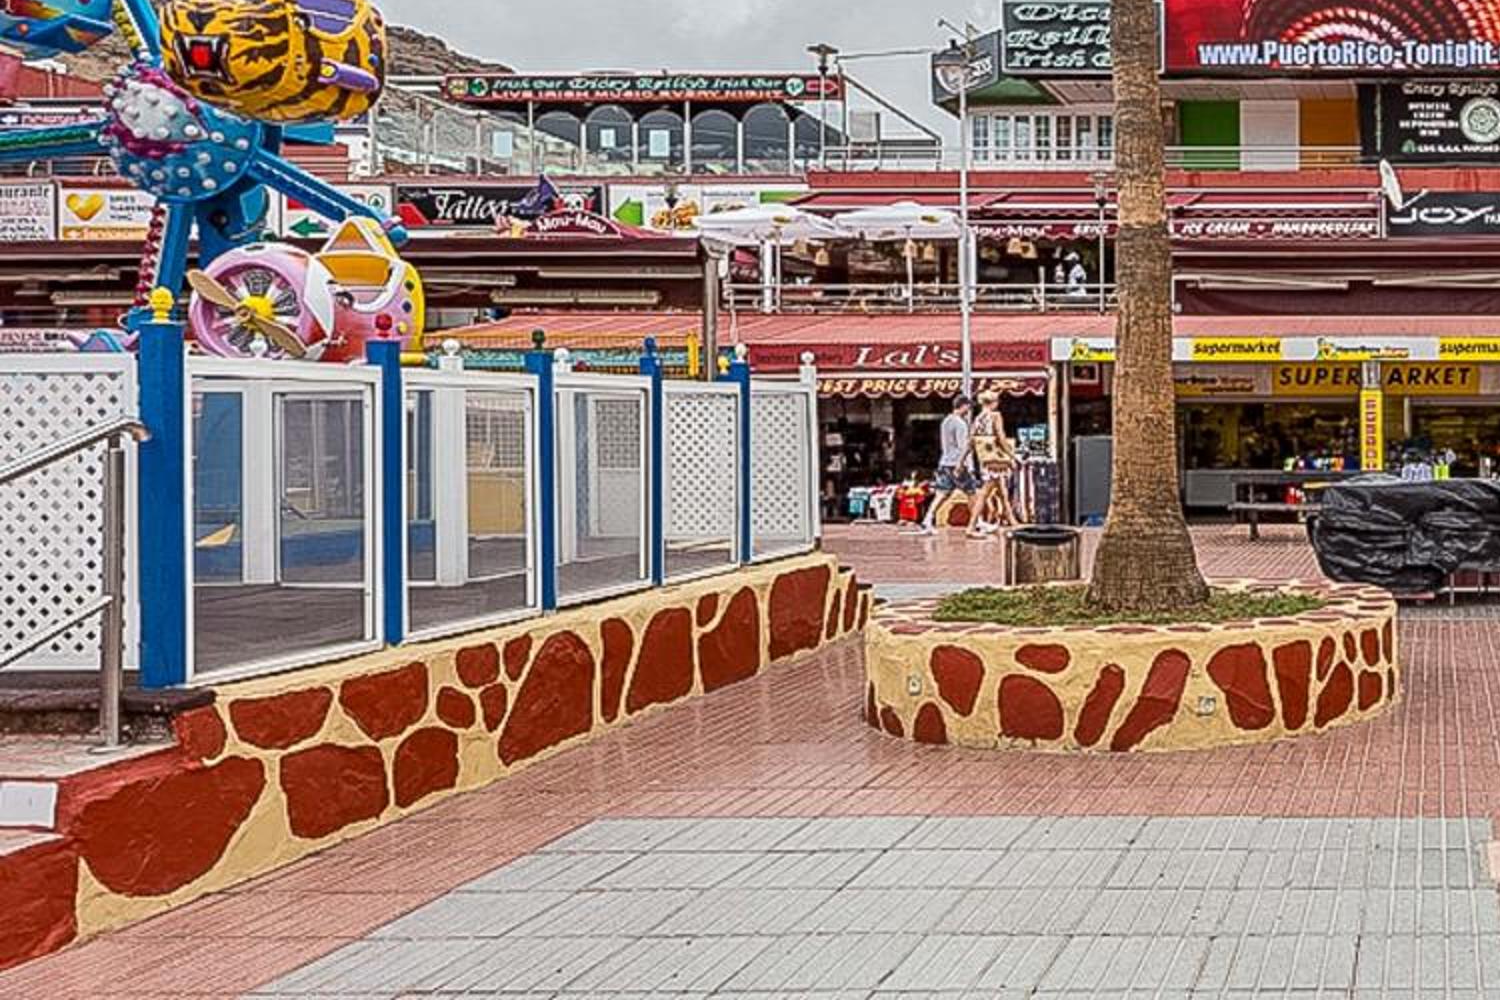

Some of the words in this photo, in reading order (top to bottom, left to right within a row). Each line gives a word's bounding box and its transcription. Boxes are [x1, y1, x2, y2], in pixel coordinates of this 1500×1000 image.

[1008, 50, 1087, 68] Irish
[1389, 205, 1495, 225] JOY
[853, 345, 962, 367] Lal's
[1193, 341, 1281, 357] supermarket
[1279, 366, 1471, 385] SUPERARKET
[860, 379, 919, 393] PRICE
[922, 379, 963, 393] SHO
